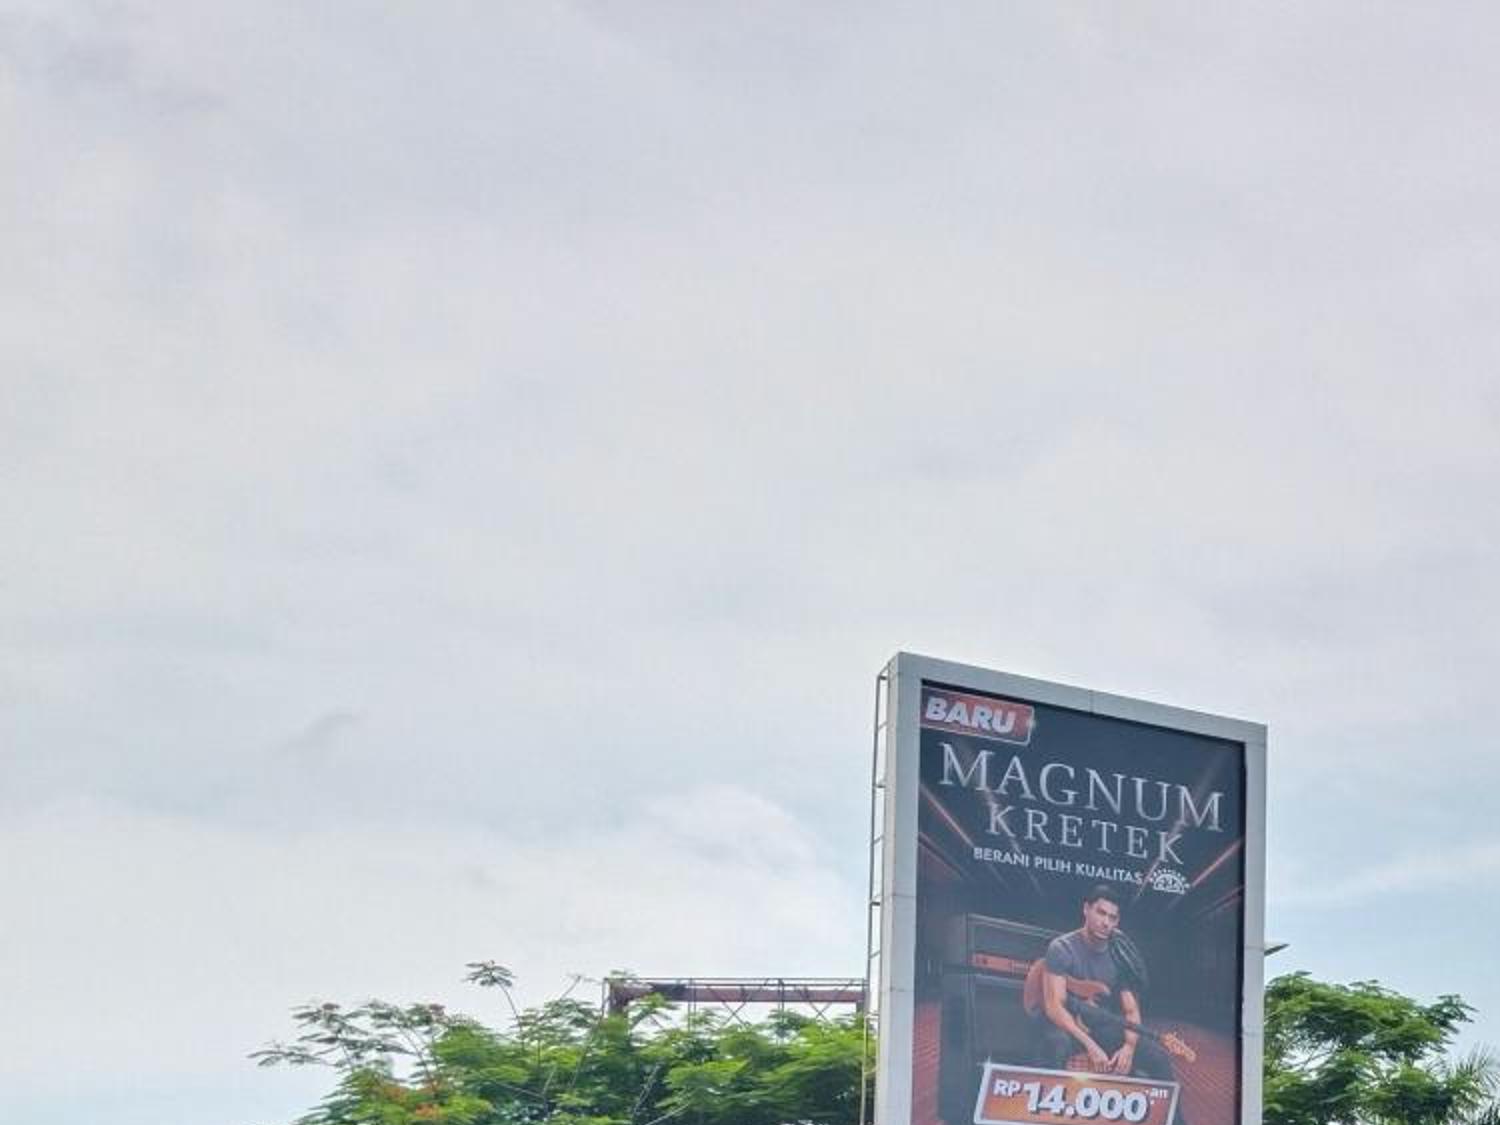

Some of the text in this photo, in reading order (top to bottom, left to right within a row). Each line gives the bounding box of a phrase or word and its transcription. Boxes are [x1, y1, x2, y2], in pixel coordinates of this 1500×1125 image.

[925, 696, 1017, 734] BARU
[939, 742, 1224, 832] MAGNUM
[986, 803, 1185, 865] KRETEK
[973, 847, 1030, 867] BERANI
[1034, 856, 1072, 873] PILIH
[1075, 860, 1143, 885] KUALITAS
[1024, 1082, 1148, 1122] 14.000
